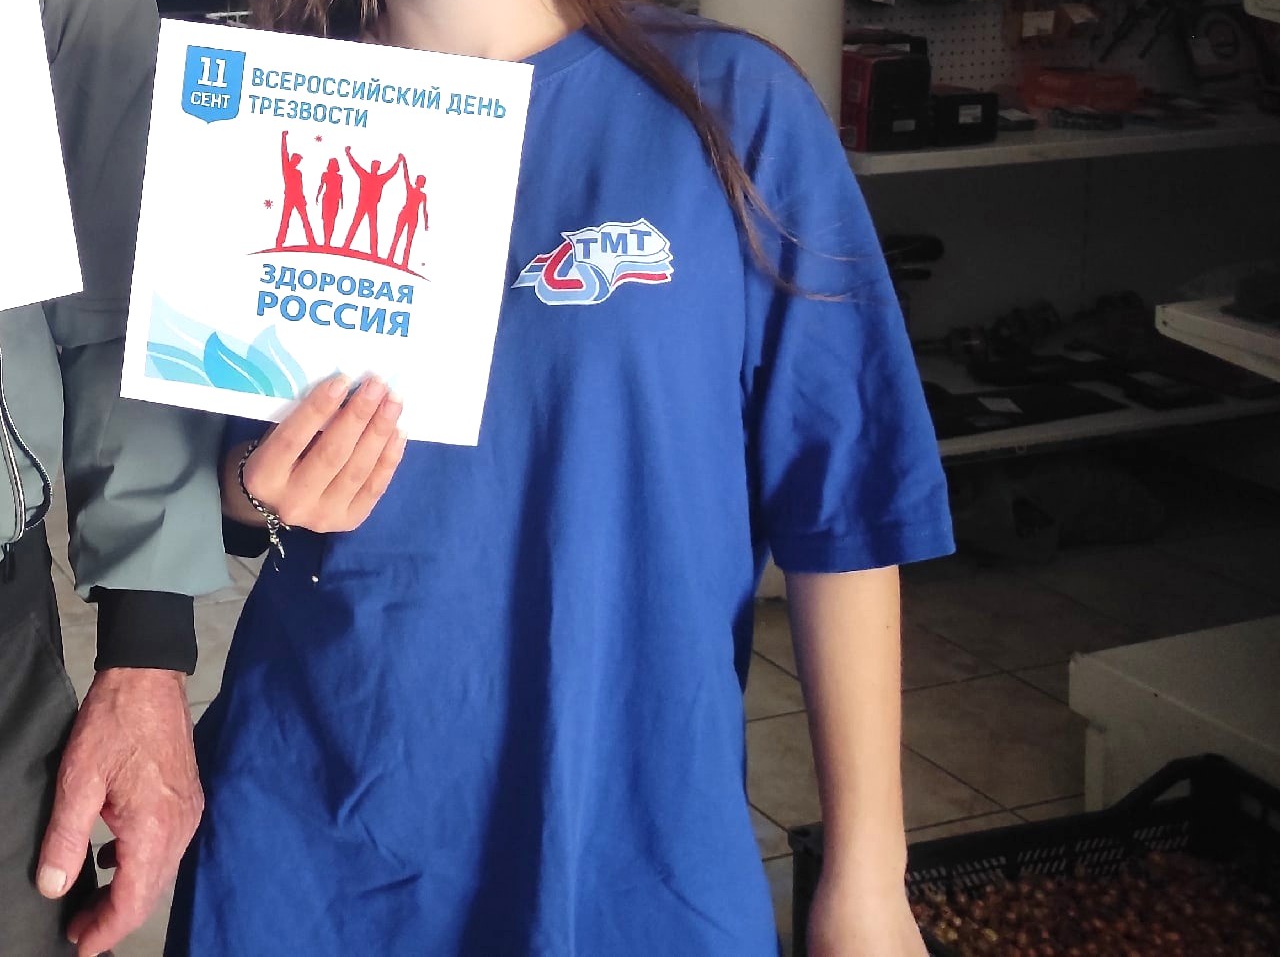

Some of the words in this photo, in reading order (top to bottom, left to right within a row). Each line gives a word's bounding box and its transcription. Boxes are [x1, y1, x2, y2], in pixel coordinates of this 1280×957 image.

[197, 56, 228, 88] 11
[190, 91, 232, 110] СЕНТ
[251, 66, 442, 111] ВСЕРОССИЙСКИЙ
[445, 92, 508, 120] ДЕНЬ
[248, 94, 370, 129] ТРЕЗВОСТИ
[575, 229, 652, 261] ТМТ
[259, 263, 415, 305] ЗДОРОВАЯ
[255, 290, 413, 338] РОССИЯ
